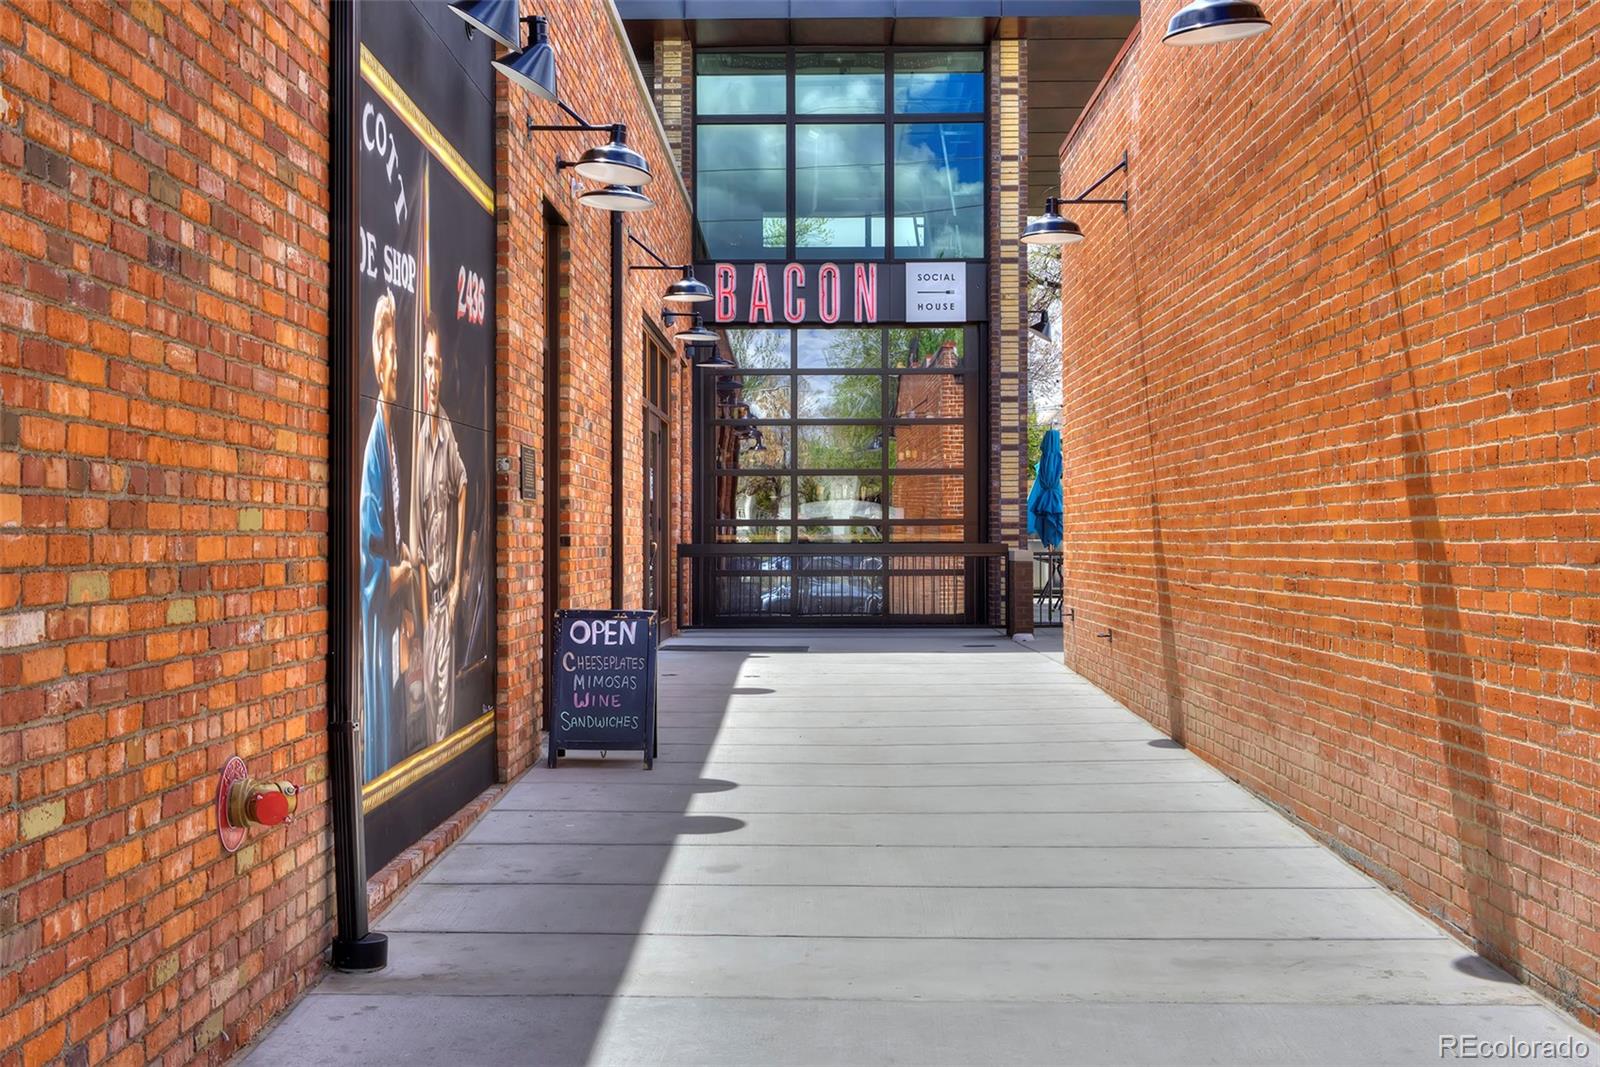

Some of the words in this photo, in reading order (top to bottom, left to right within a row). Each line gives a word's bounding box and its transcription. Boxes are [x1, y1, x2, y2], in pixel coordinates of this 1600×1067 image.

[359, 101, 407, 224] COTT
[383, 244, 416, 294] SHOP
[917, 273, 956, 282] SOCIAL
[457, 265, 486, 326] 2436
[714, 262, 878, 324] BACON
[917, 302, 955, 311] HOUSE
[569, 619, 638, 646] OPEN
[562, 651, 646, 672] CHEESEPLATES
[573, 674, 637, 691] MIMOSAS
[573, 692, 622, 708] WINE
[560, 711, 639, 731] SANDWICHES
